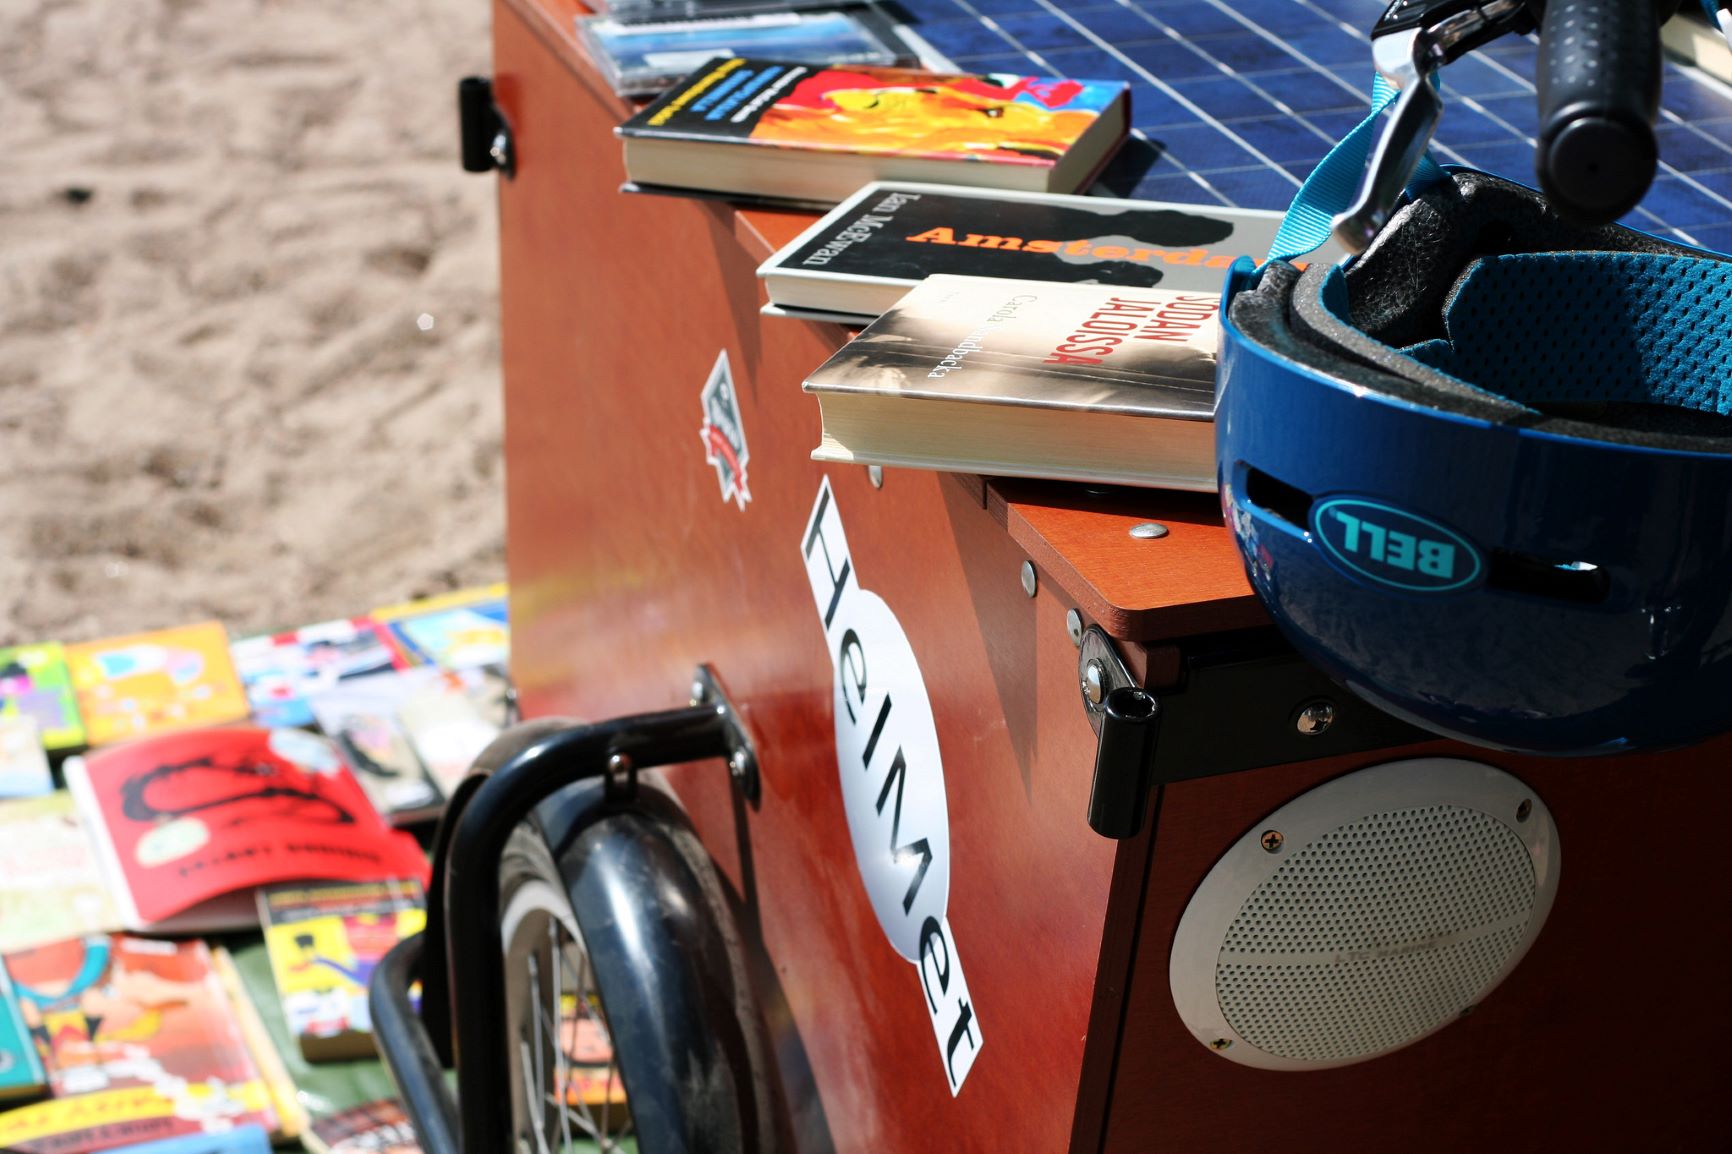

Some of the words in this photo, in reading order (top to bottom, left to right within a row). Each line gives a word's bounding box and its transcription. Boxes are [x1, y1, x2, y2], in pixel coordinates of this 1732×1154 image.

[872, 192, 921, 212] Ian
[802, 214, 893, 265] McEwan
[906, 227, 1309, 272] Amsterda
[986, 295, 1038, 322] Carola
[1042, 297, 1161, 365] JALOISSA
[1134, 296, 1220, 342] SODAN
[1336, 511, 1455, 579] BELL
[805, 491, 977, 1088] HelMet
